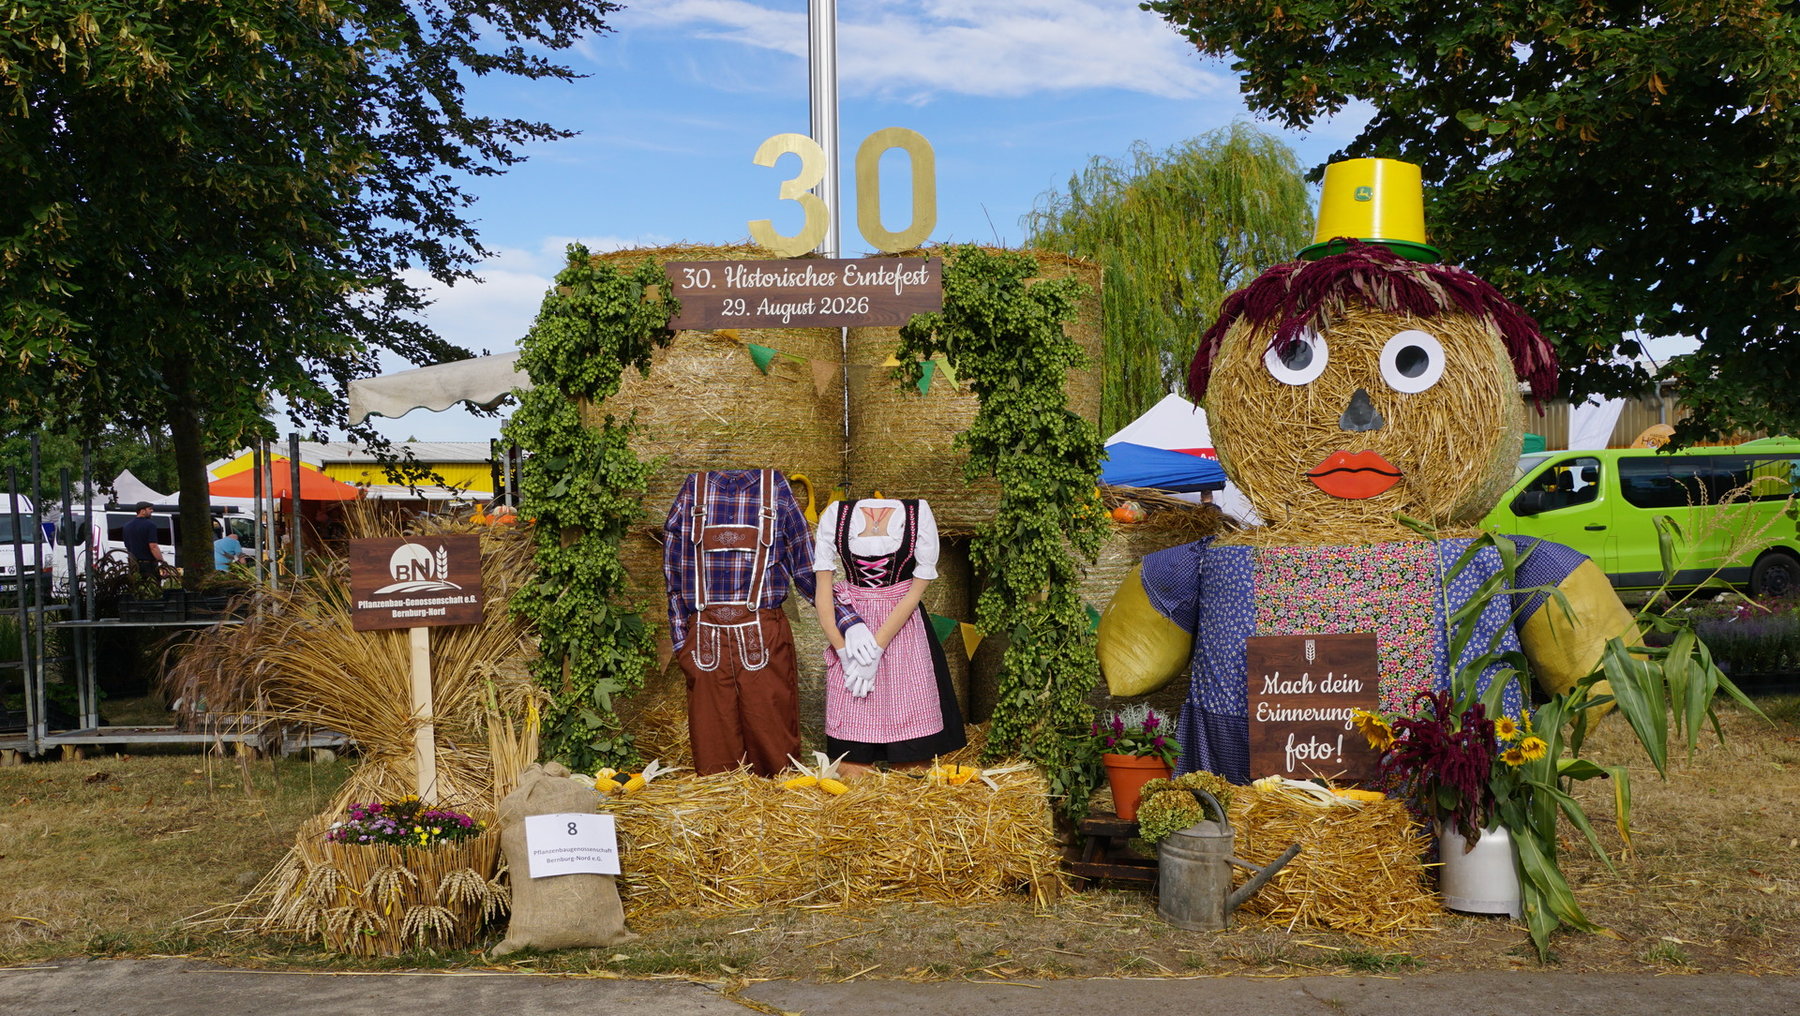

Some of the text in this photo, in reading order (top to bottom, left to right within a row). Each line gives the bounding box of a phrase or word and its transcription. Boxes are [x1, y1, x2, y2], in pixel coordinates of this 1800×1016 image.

[747, 126, 937, 258] 30
[681, 262, 930, 296] 30. Historisches Erntefest
[721, 296, 869, 324] 29. August 2026
[395, 558, 431, 581] BN
[358, 594, 477, 609] Pflanzenbau-Genossenschaft e.G.
[391, 606, 446, 619] Bernburg-Nord
[1260, 671, 1364, 695] Mach dein
[1256, 701, 1370, 731] Erinnerung
[1285, 732, 1344, 773] foto!
[567, 821, 578, 836] 8
[533, 846, 613, 856] Pflanzenbaugenossenschaft
[546, 854, 591, 864] Bernburg-Nord
